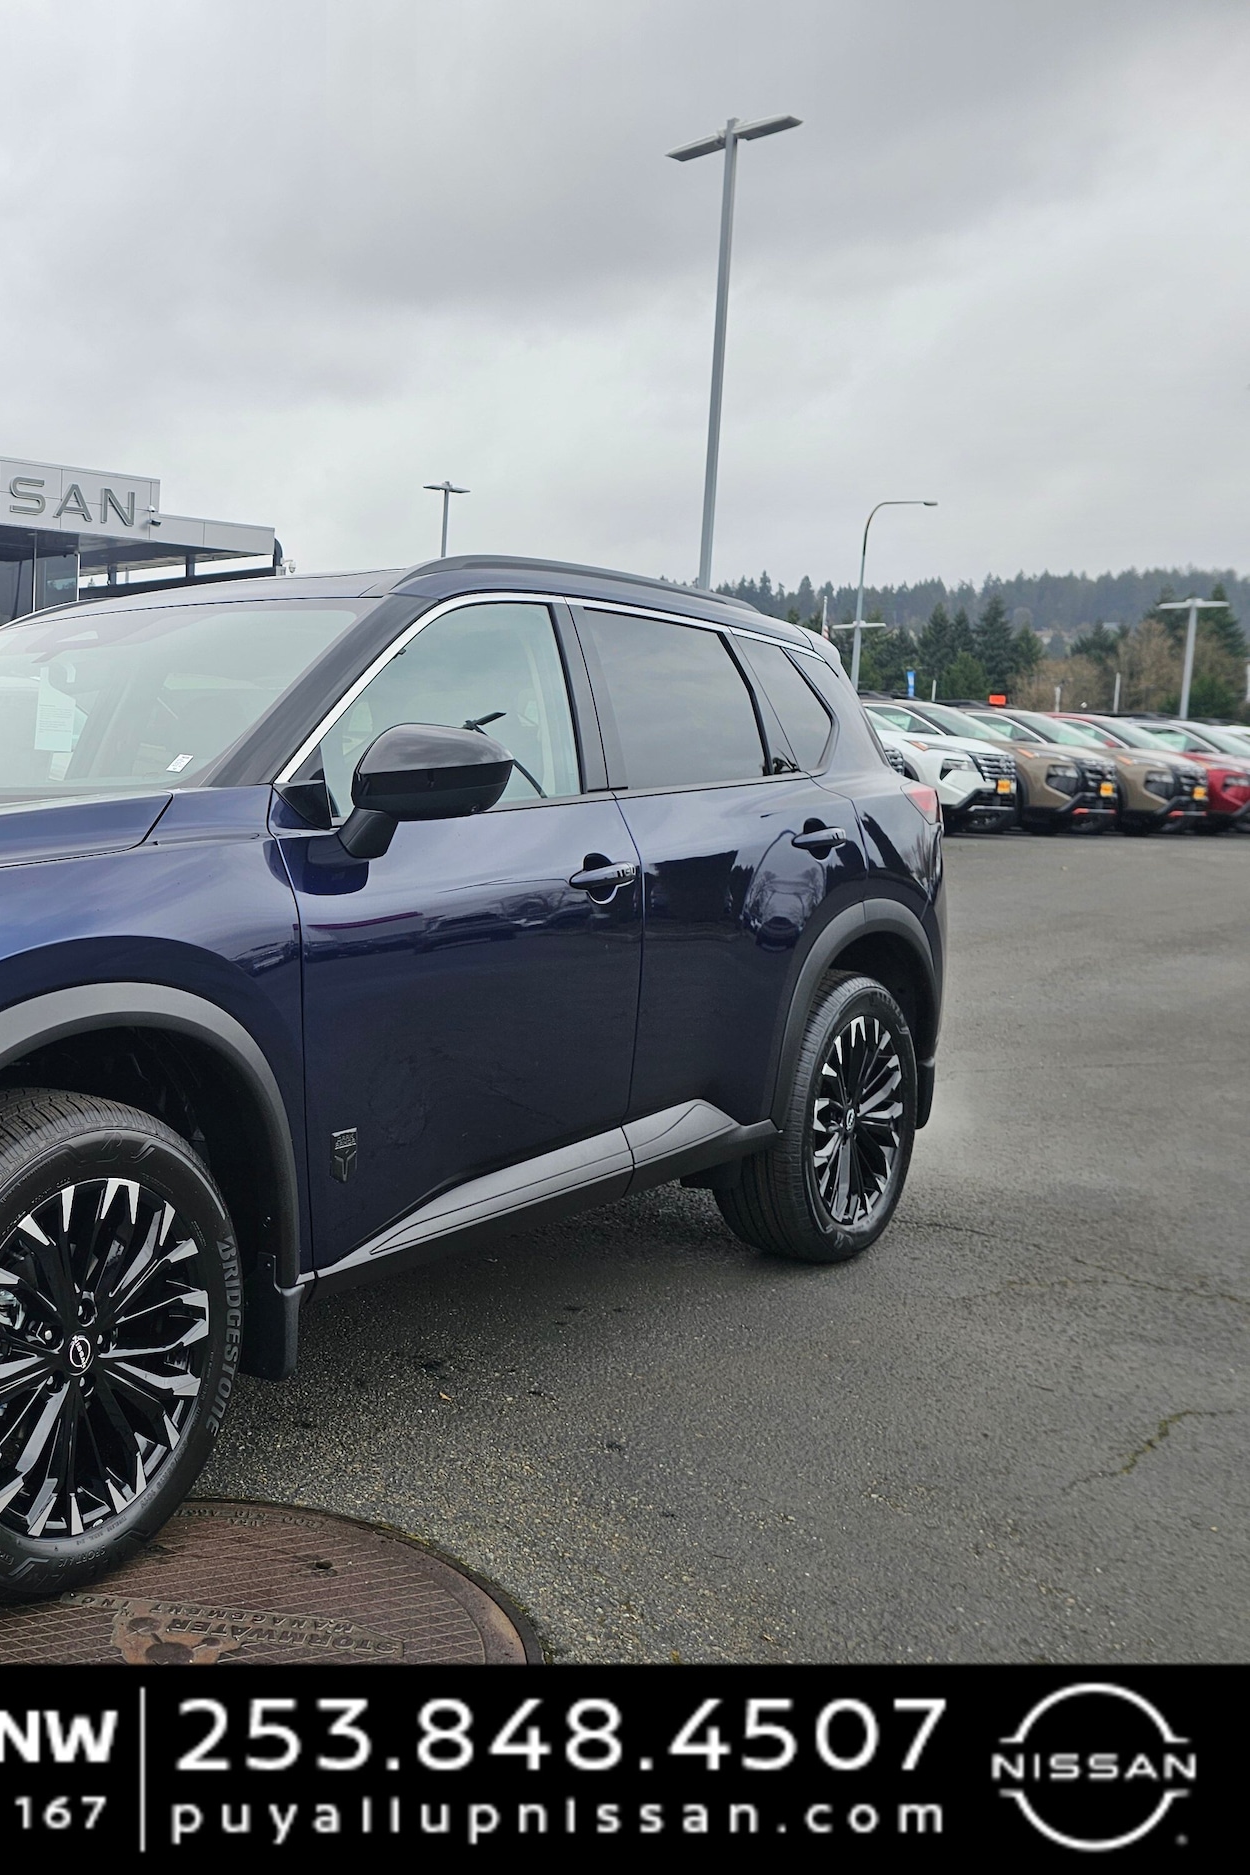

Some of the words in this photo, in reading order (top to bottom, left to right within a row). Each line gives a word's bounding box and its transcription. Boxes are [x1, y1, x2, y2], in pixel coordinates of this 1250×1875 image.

[206, 1235, 242, 1437] BRIDGESTONE
[151, 1604, 356, 1634] MANAGEMENT
[166, 1617, 400, 1655] STORMWATER
